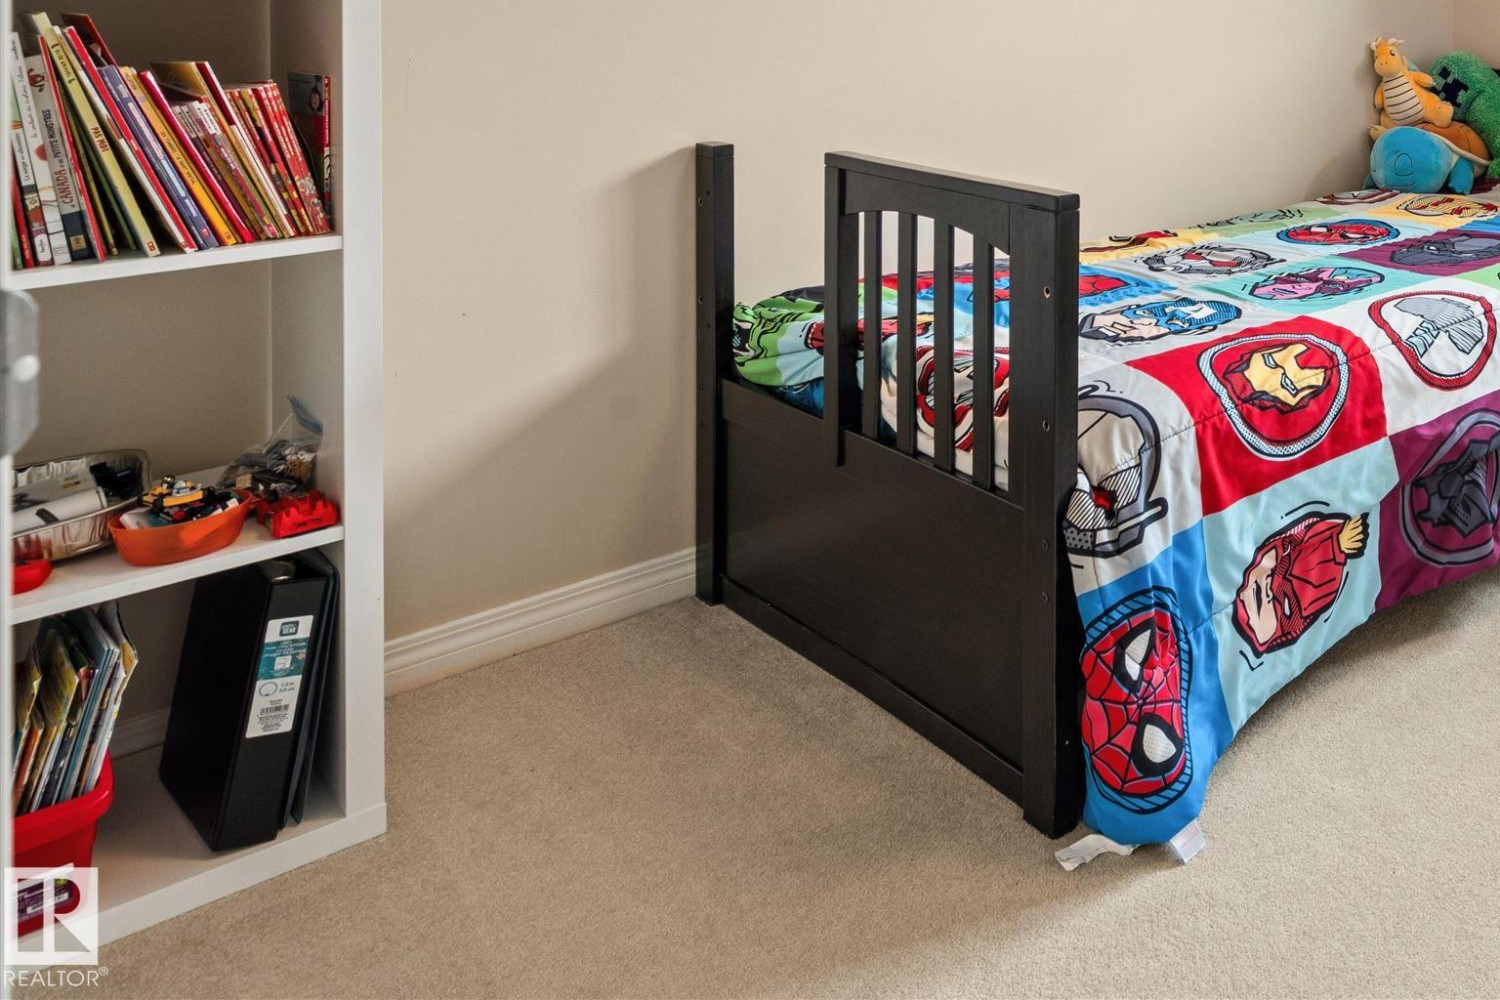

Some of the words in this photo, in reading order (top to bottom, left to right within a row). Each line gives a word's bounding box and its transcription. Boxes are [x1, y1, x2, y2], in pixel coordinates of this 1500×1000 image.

[42, 109, 56, 140] MONSTRES
[91, 127, 101, 140] PAS
[54, 169, 73, 204] CANADA
